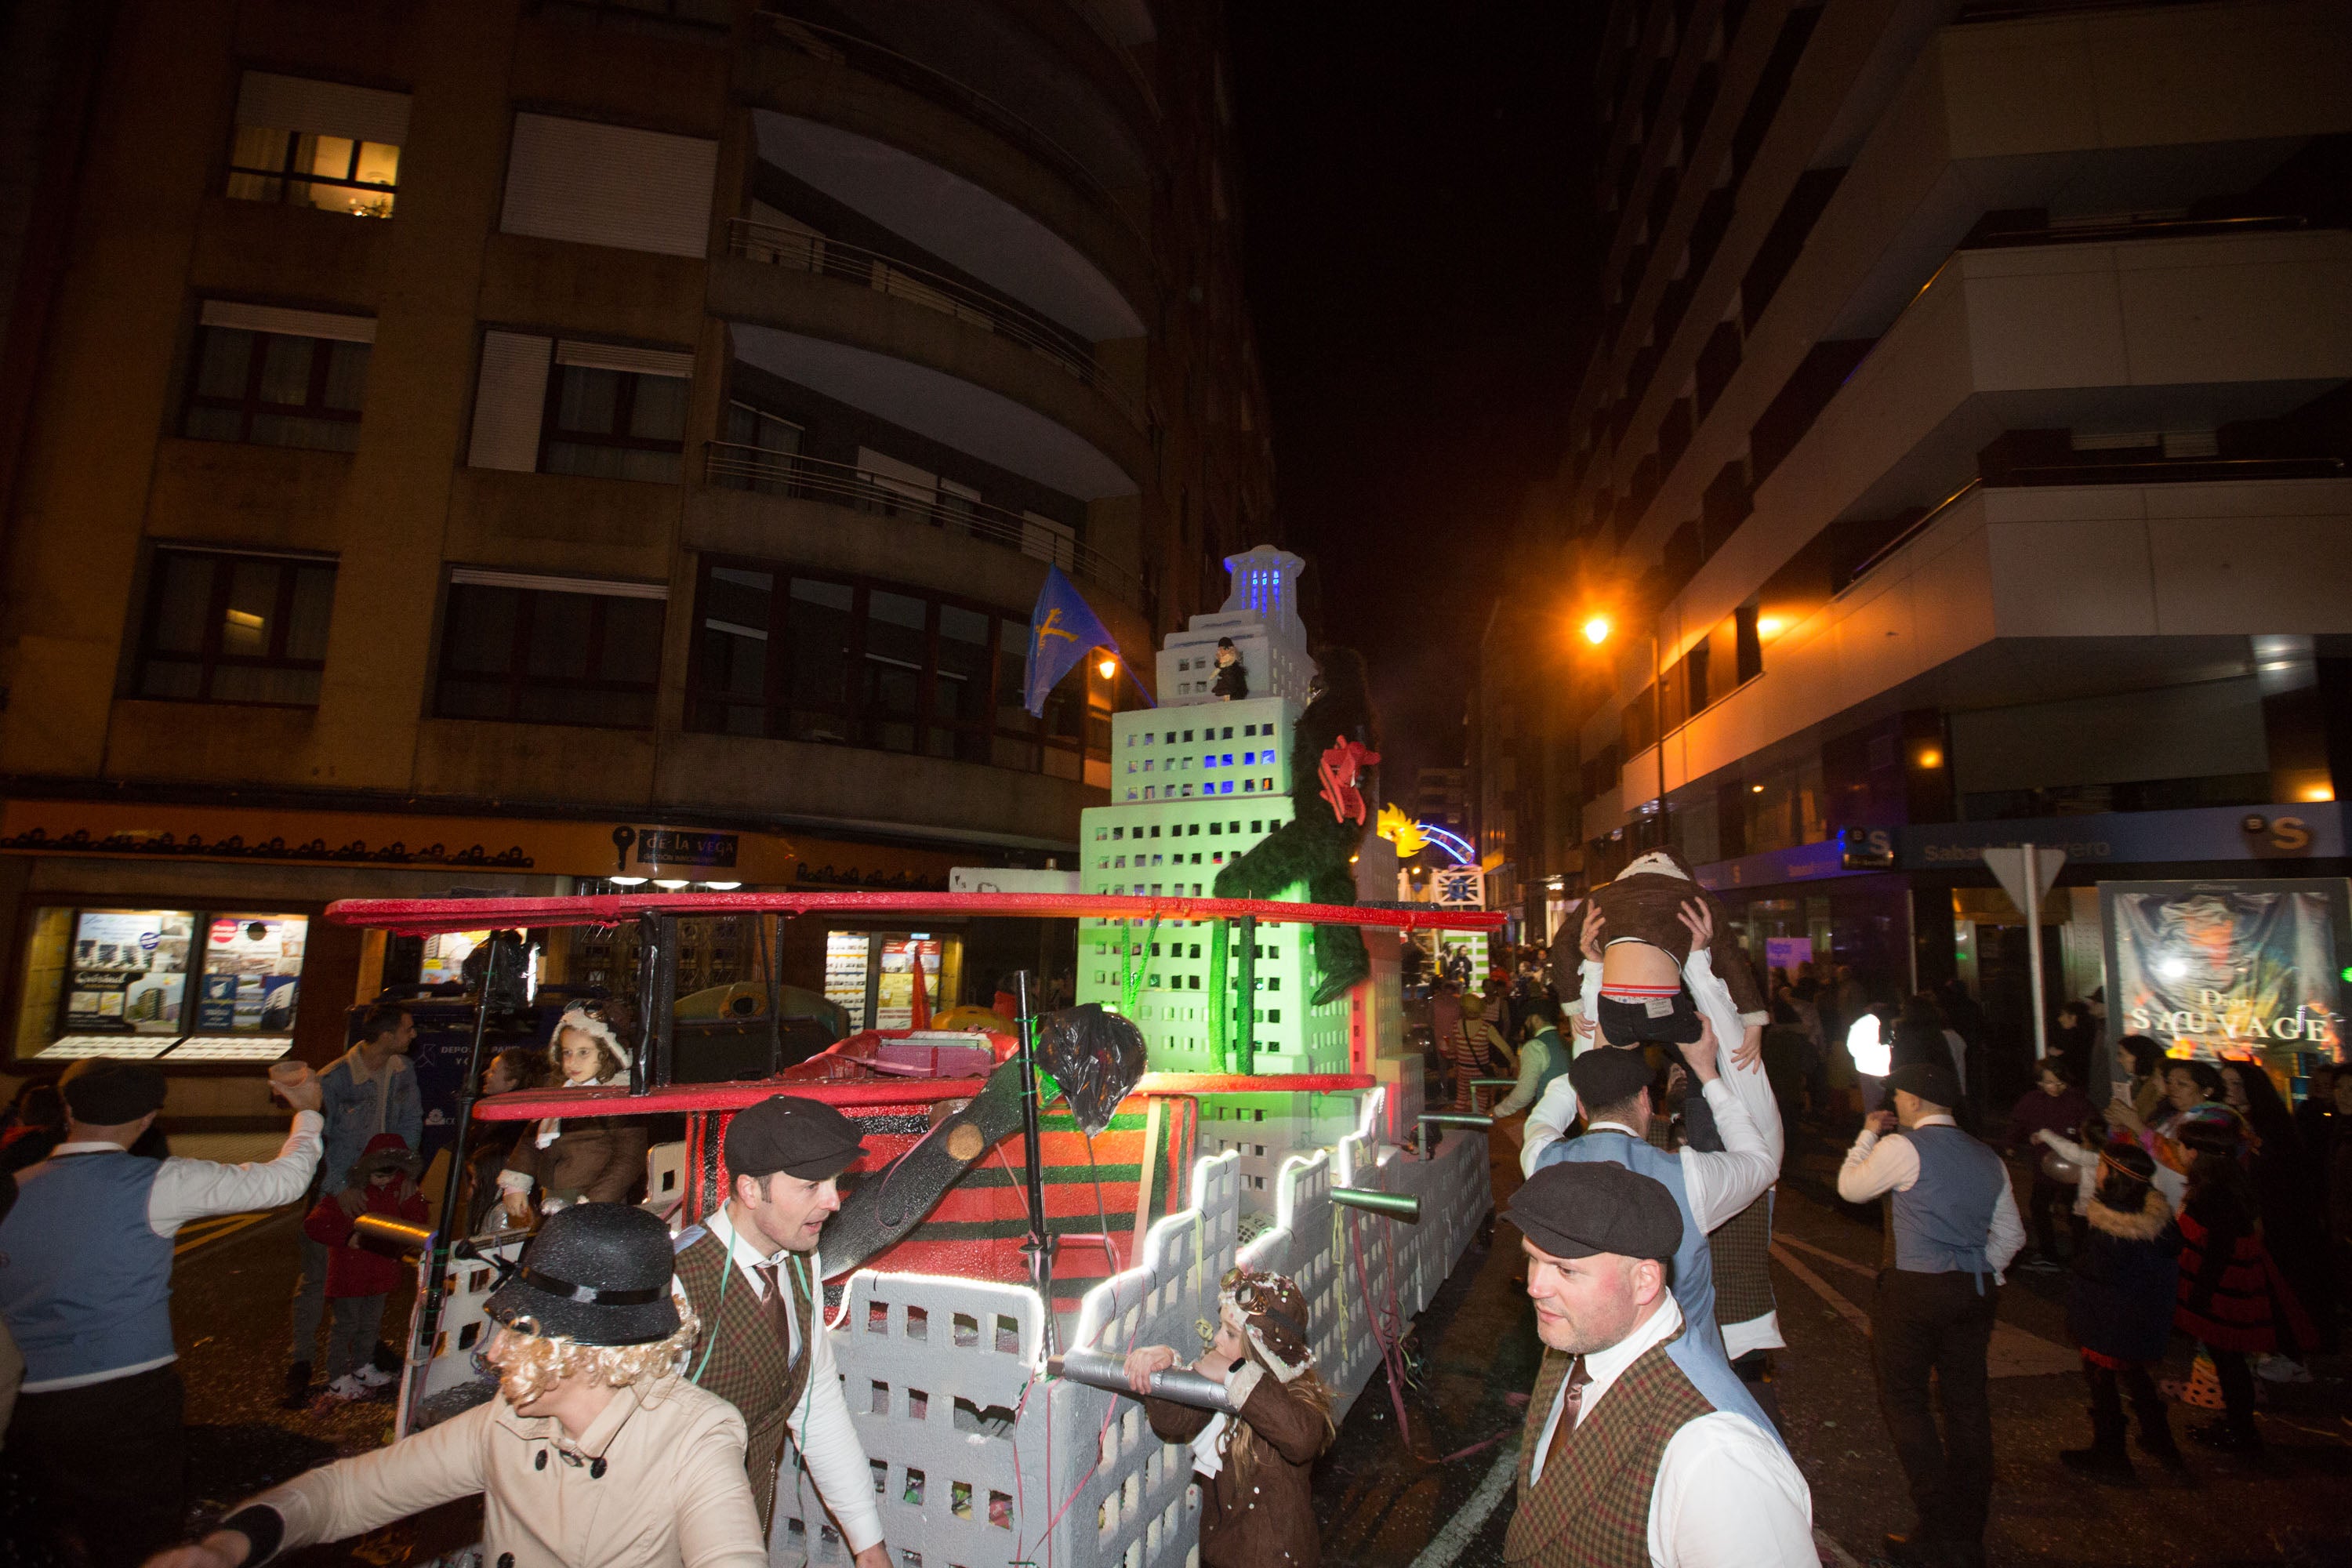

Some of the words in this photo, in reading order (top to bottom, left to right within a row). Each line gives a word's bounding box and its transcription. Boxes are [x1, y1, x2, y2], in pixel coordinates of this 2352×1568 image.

[1869, 831, 1890, 855] S
[2271, 817, 2309, 850] S
[2201, 989, 2250, 1007] Dior
[2131, 1008, 2332, 1043] SAUVAGE
